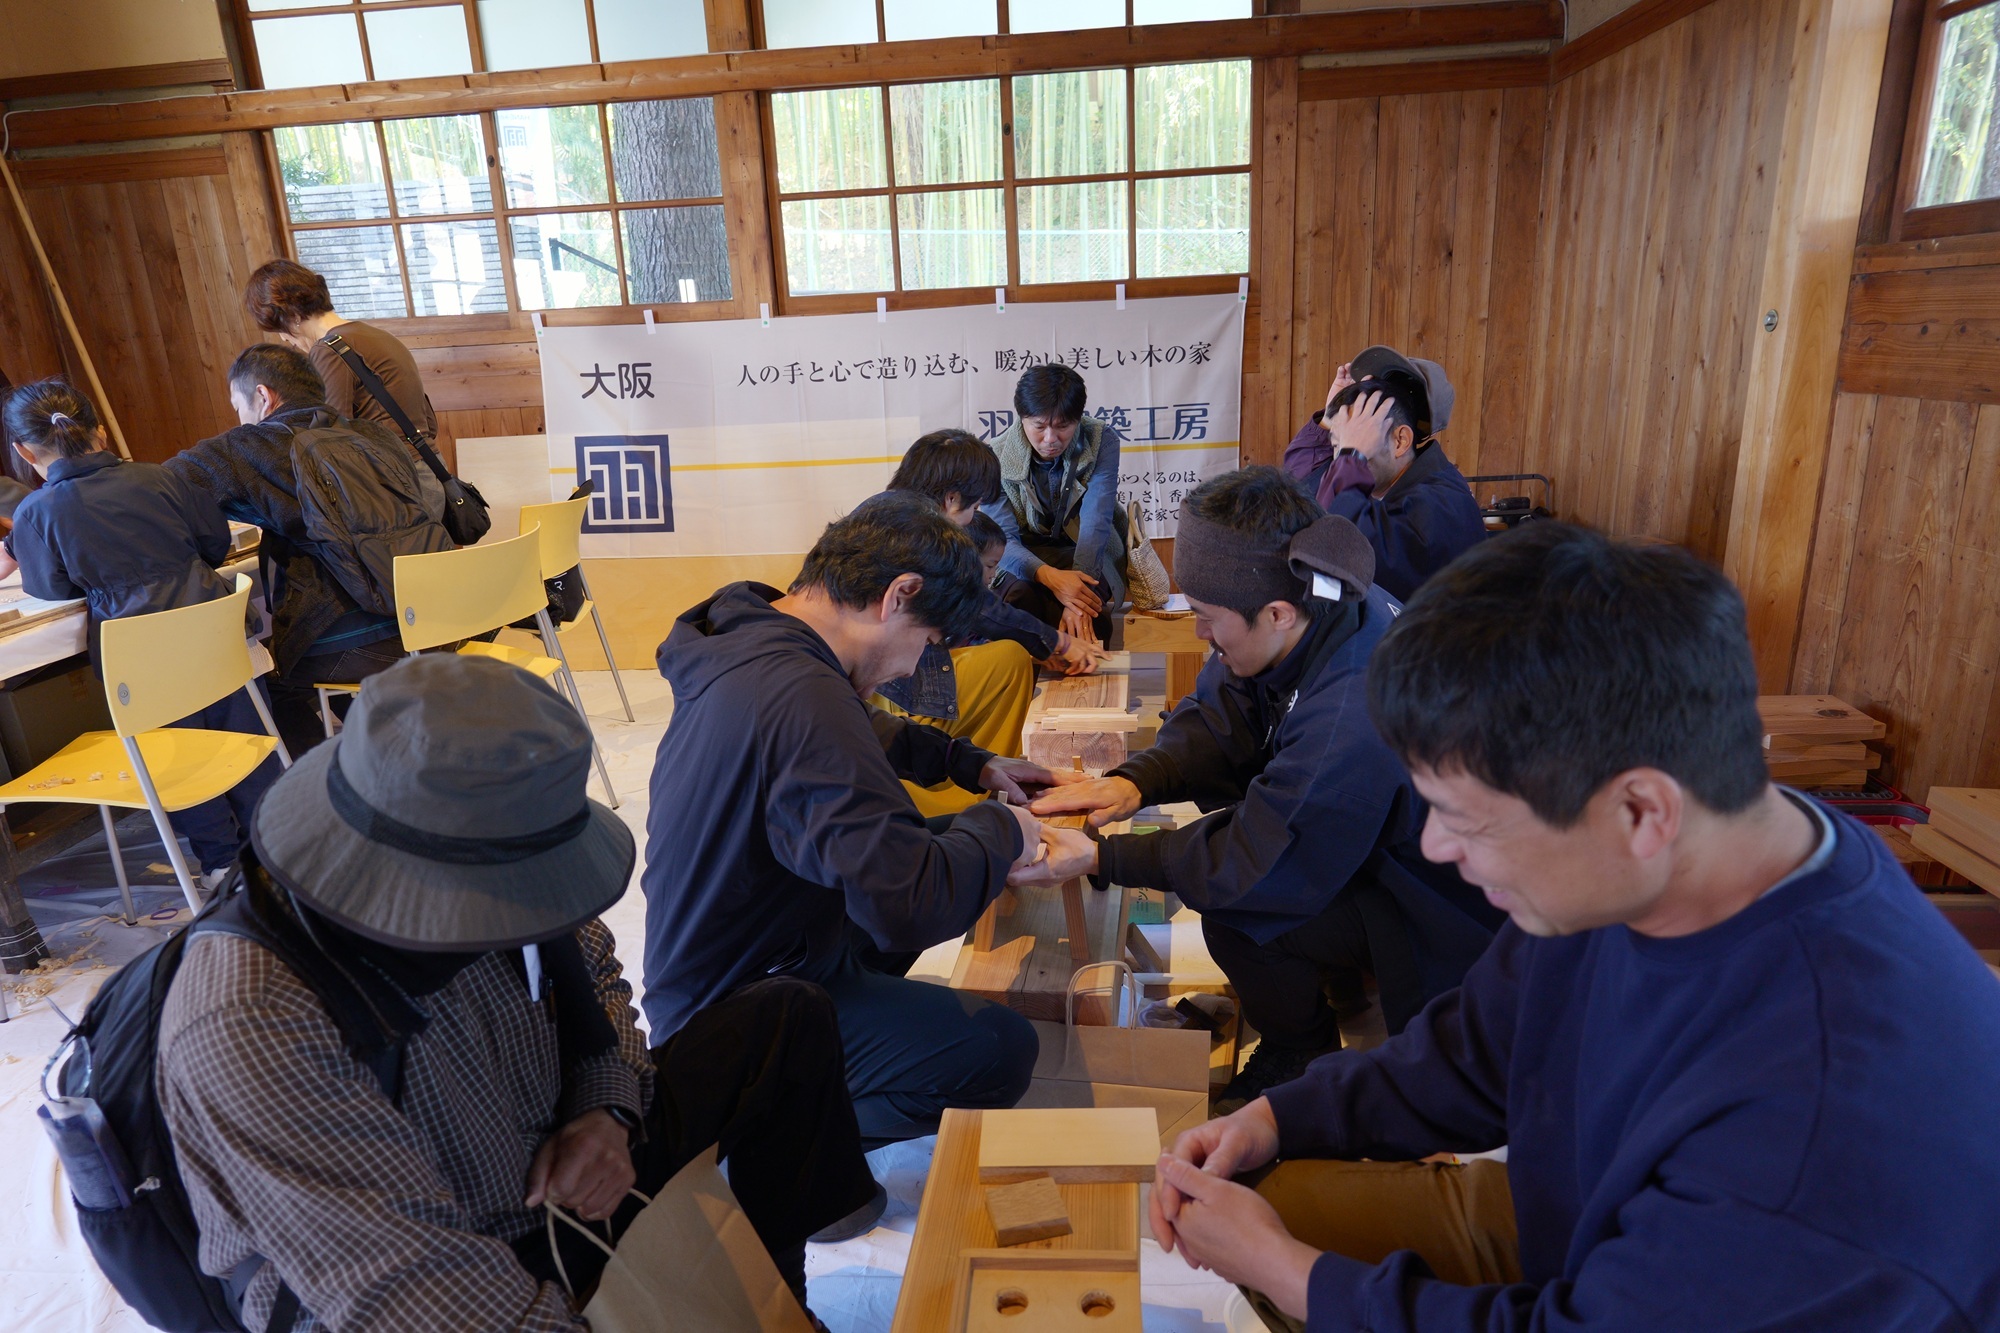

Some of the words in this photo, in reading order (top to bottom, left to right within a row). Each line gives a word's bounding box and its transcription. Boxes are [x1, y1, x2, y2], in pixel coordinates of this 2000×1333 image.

[580, 363, 655, 399] 大阪
[737, 342, 1212, 387] 人の手と心で造り込む、暖かい美しい木の家
[978, 402, 1210, 442] 羽築工房
